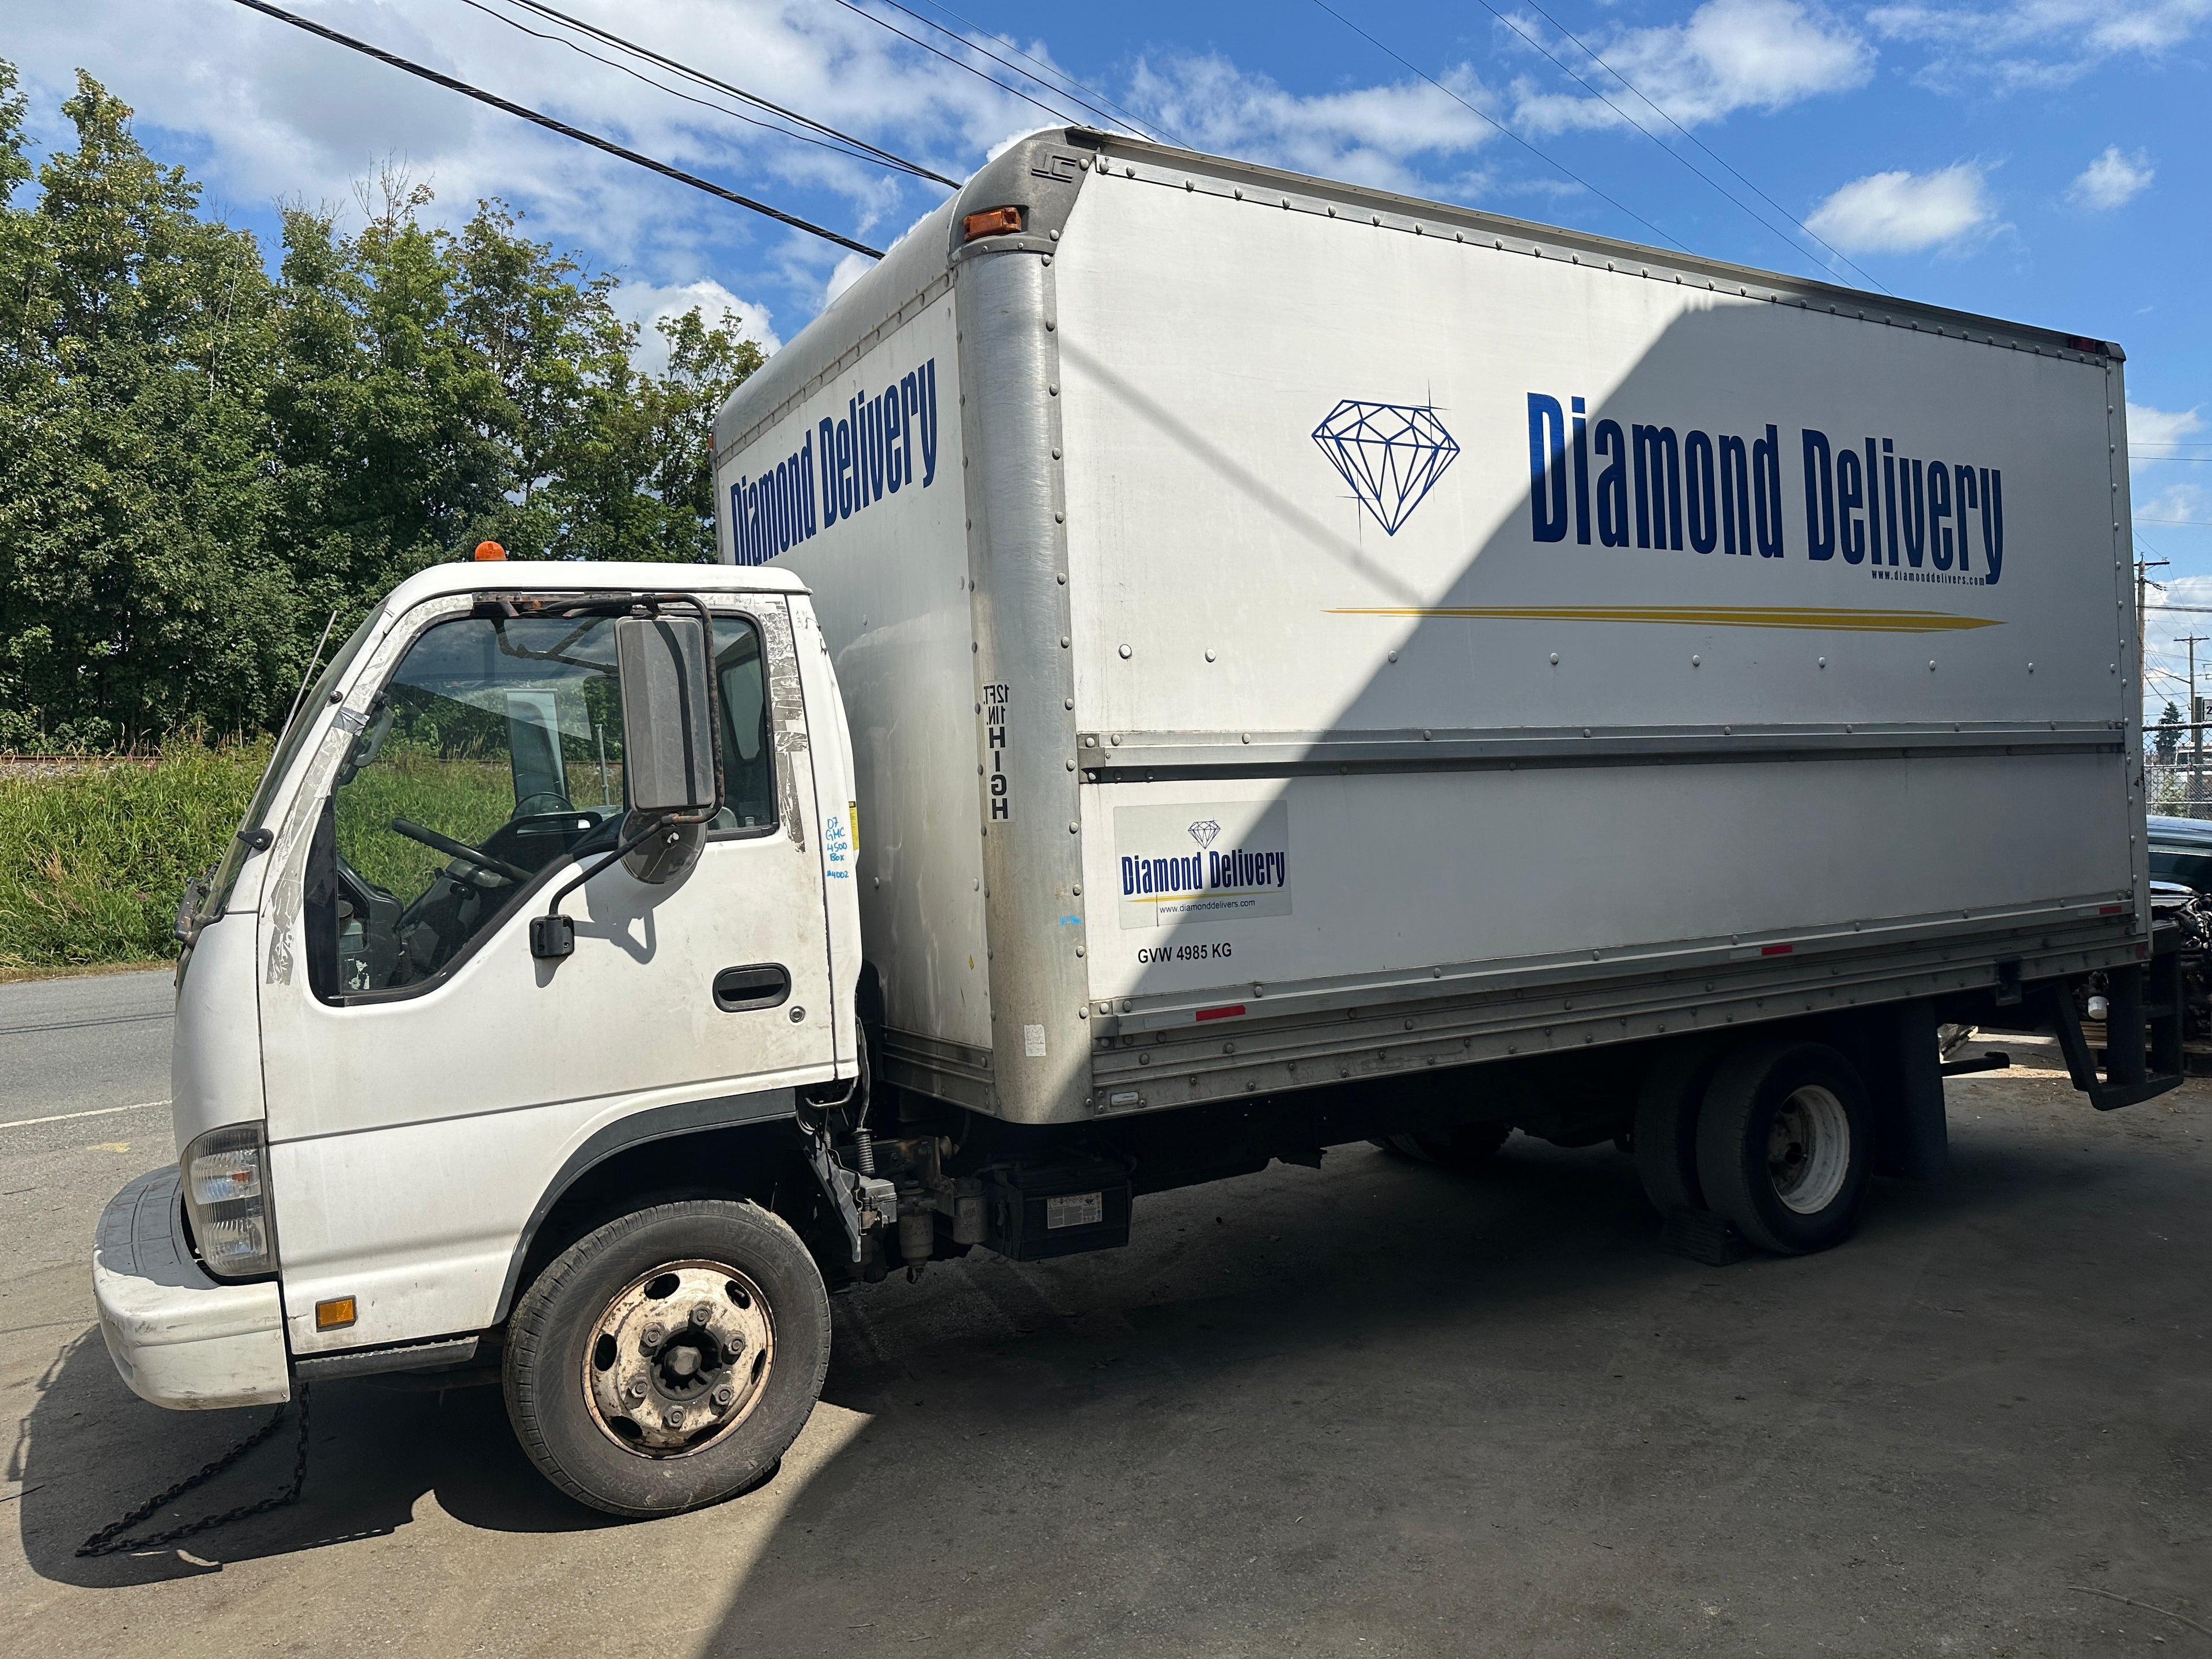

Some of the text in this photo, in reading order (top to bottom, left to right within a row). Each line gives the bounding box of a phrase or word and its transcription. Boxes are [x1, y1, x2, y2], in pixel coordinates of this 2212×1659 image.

[730, 358, 937, 566] Diamond Delivery
[1527, 392, 2003, 585] Diamond Delivery
[1872, 570, 1985, 586] www.diamonddelivers.com
[825, 827, 845, 841] GMC
[827, 842, 847, 853] 4500
[1122, 849, 1286, 895] Diamond Delivery
[1160, 899, 1255, 914] www.diamonddelivers.com
[1138, 942, 1232, 964] GVW 4985 KG
